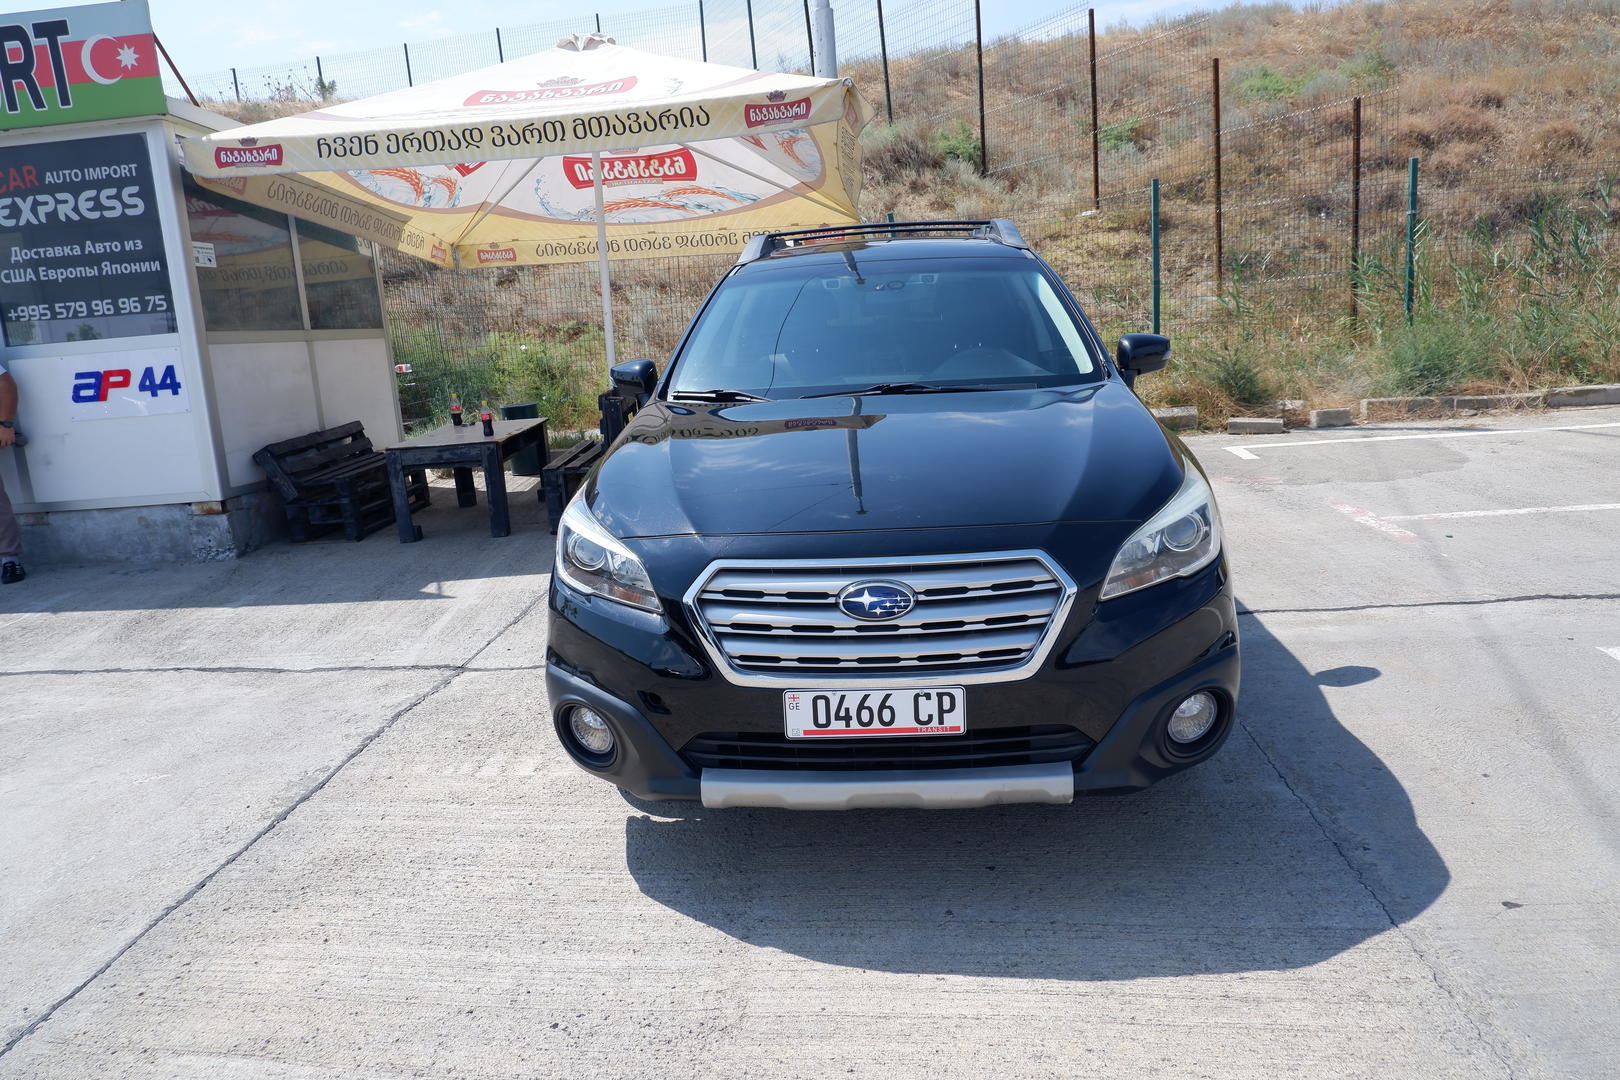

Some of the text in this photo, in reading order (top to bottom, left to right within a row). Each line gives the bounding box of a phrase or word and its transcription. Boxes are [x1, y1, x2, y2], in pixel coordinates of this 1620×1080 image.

[750, 102, 807, 122] ნატახტარი
[316, 105, 711, 159] ჩვენ ერთად ვართ მთავარია
[220, 147, 278, 163] ნატახტარი
[45, 168, 82, 185] AUTO
[85, 163, 138, 181] IMPORT
[0, 185, 145, 228] EXPRESS
[10, 239, 143, 264] Доставка Авто из
[0, 260, 161, 283] США Европы Японии
[8, 295, 167, 321] +995 579 96 96 75
[138, 364, 181, 398] 44
[788, 702, 801, 711] GE
[811, 690, 957, 729] 0466 CP
